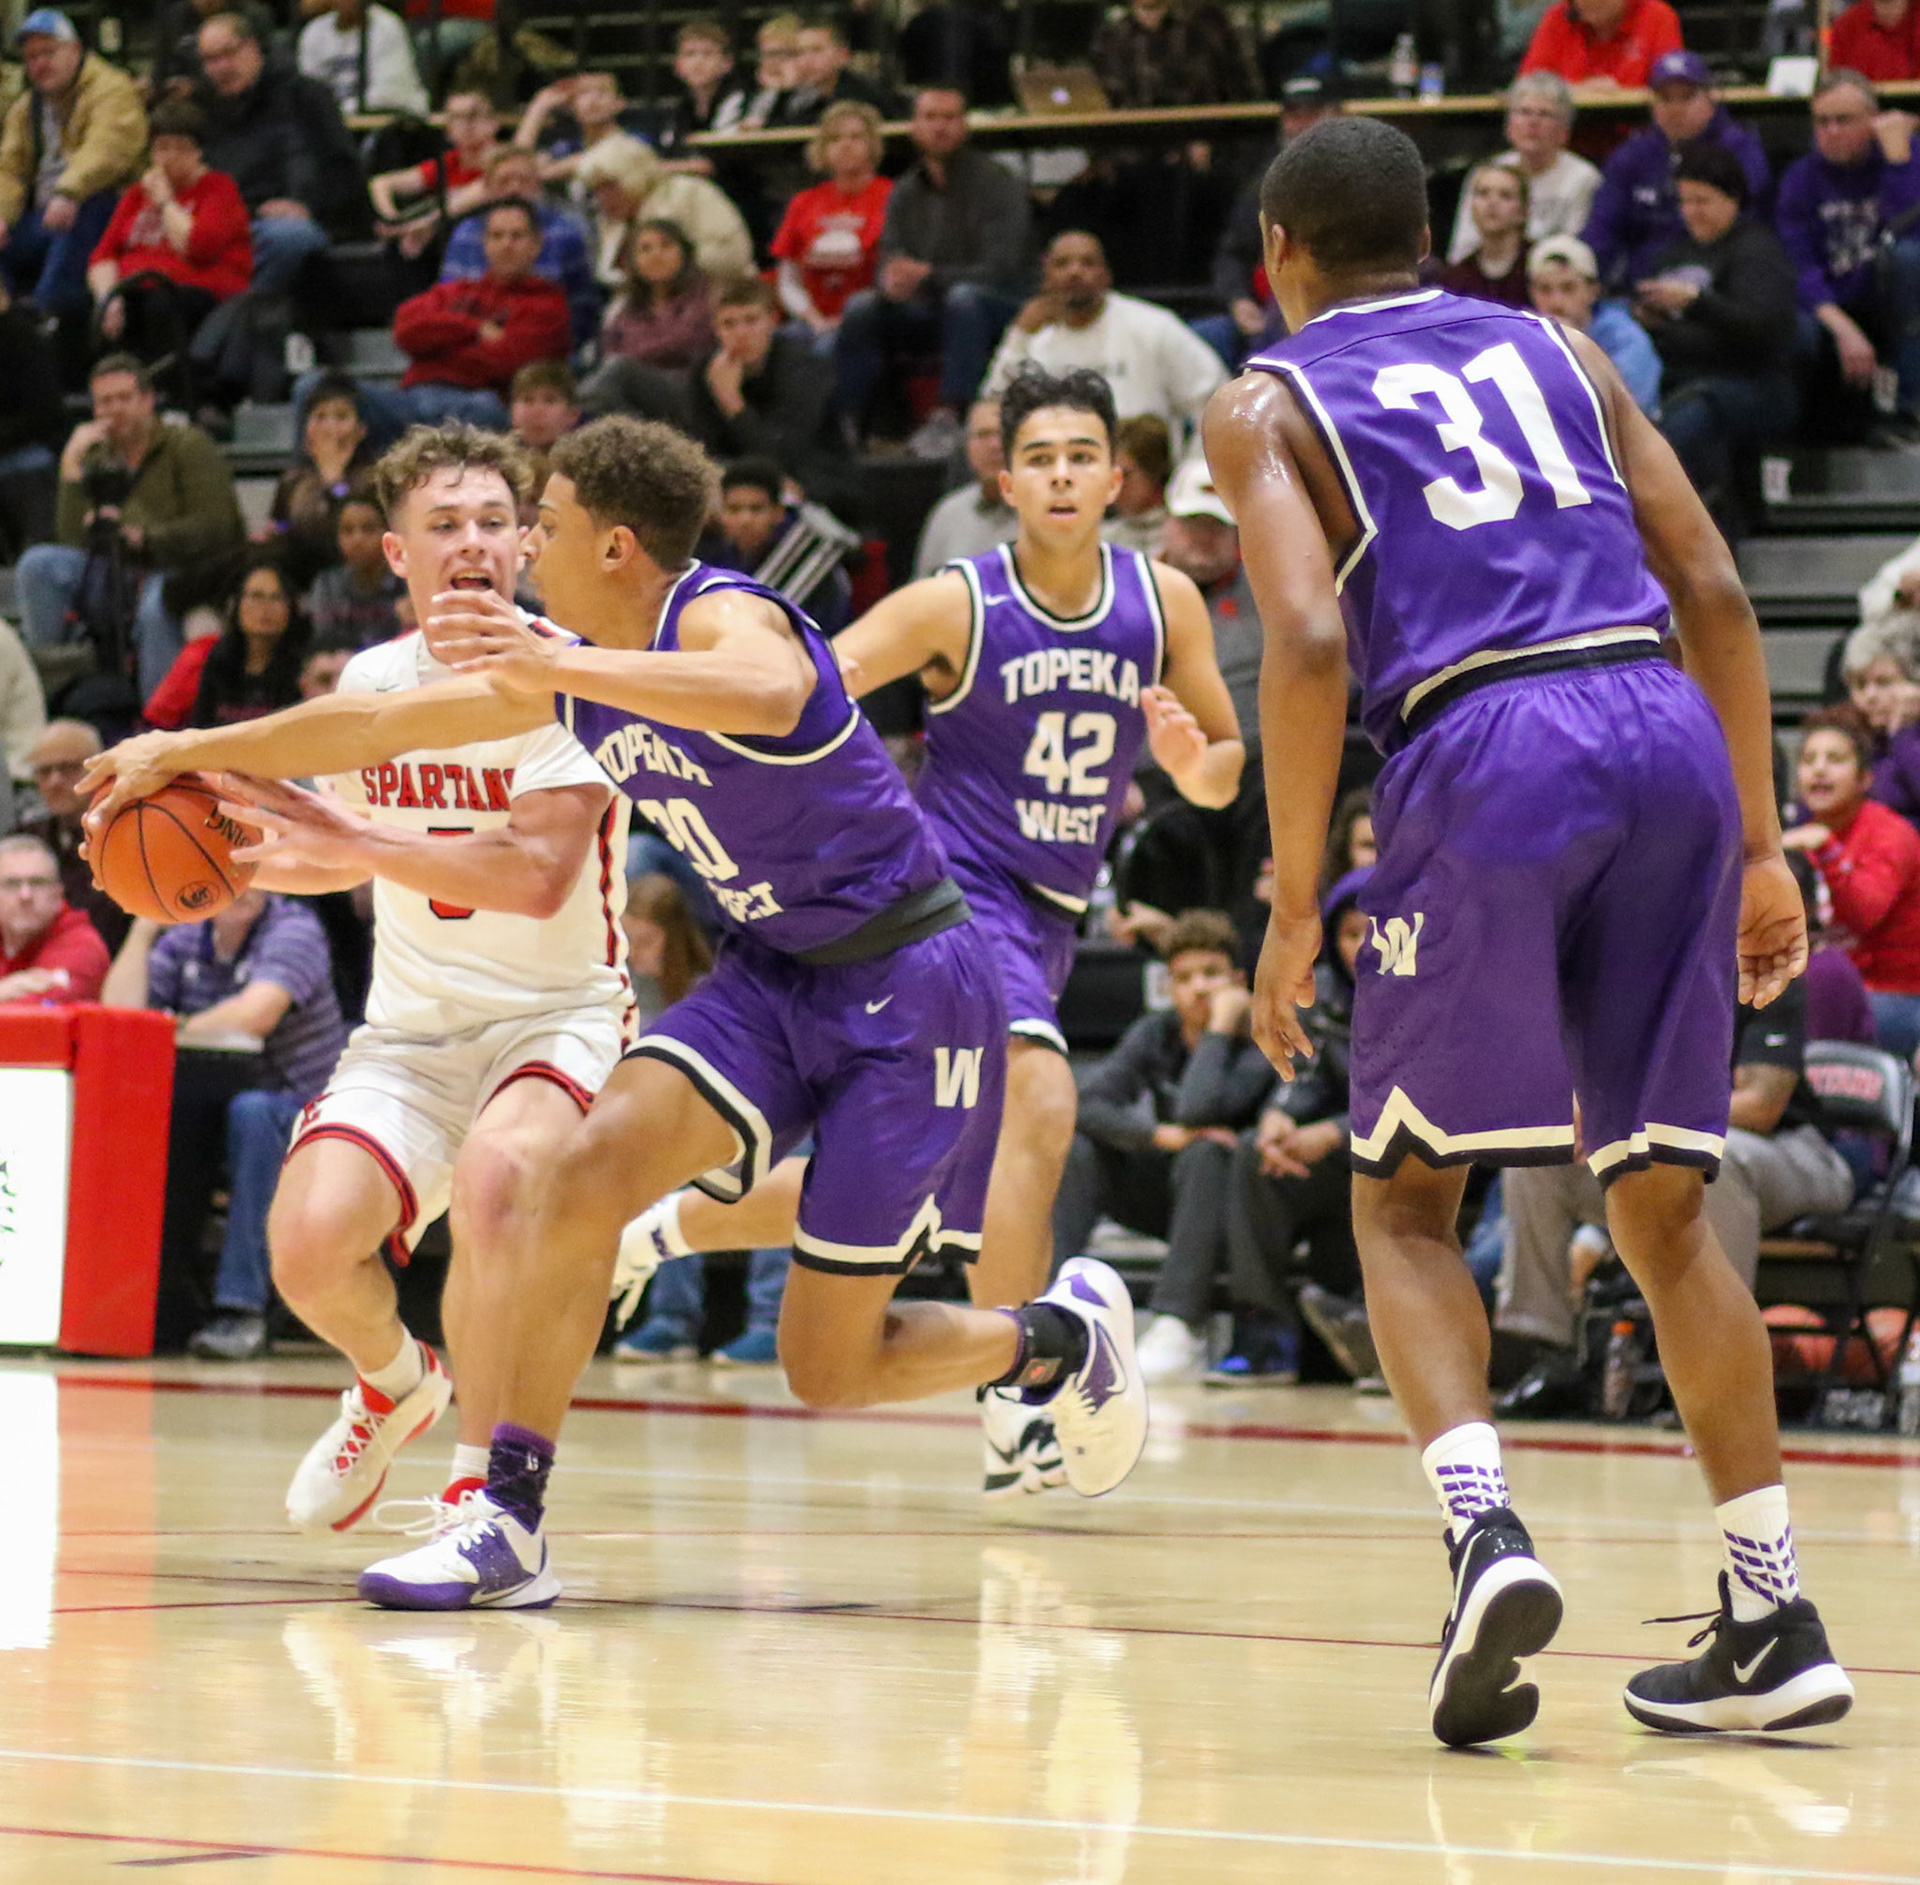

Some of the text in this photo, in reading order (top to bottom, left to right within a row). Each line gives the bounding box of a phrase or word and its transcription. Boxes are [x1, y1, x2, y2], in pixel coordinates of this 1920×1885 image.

[1371, 341, 1592, 531] 31
[1000, 648, 1139, 709] TOPEKA
[1024, 712, 1117, 796] 42
[1015, 798, 1107, 845] WEST
[1368, 911, 1424, 976] W
[934, 1046, 984, 1109] W
